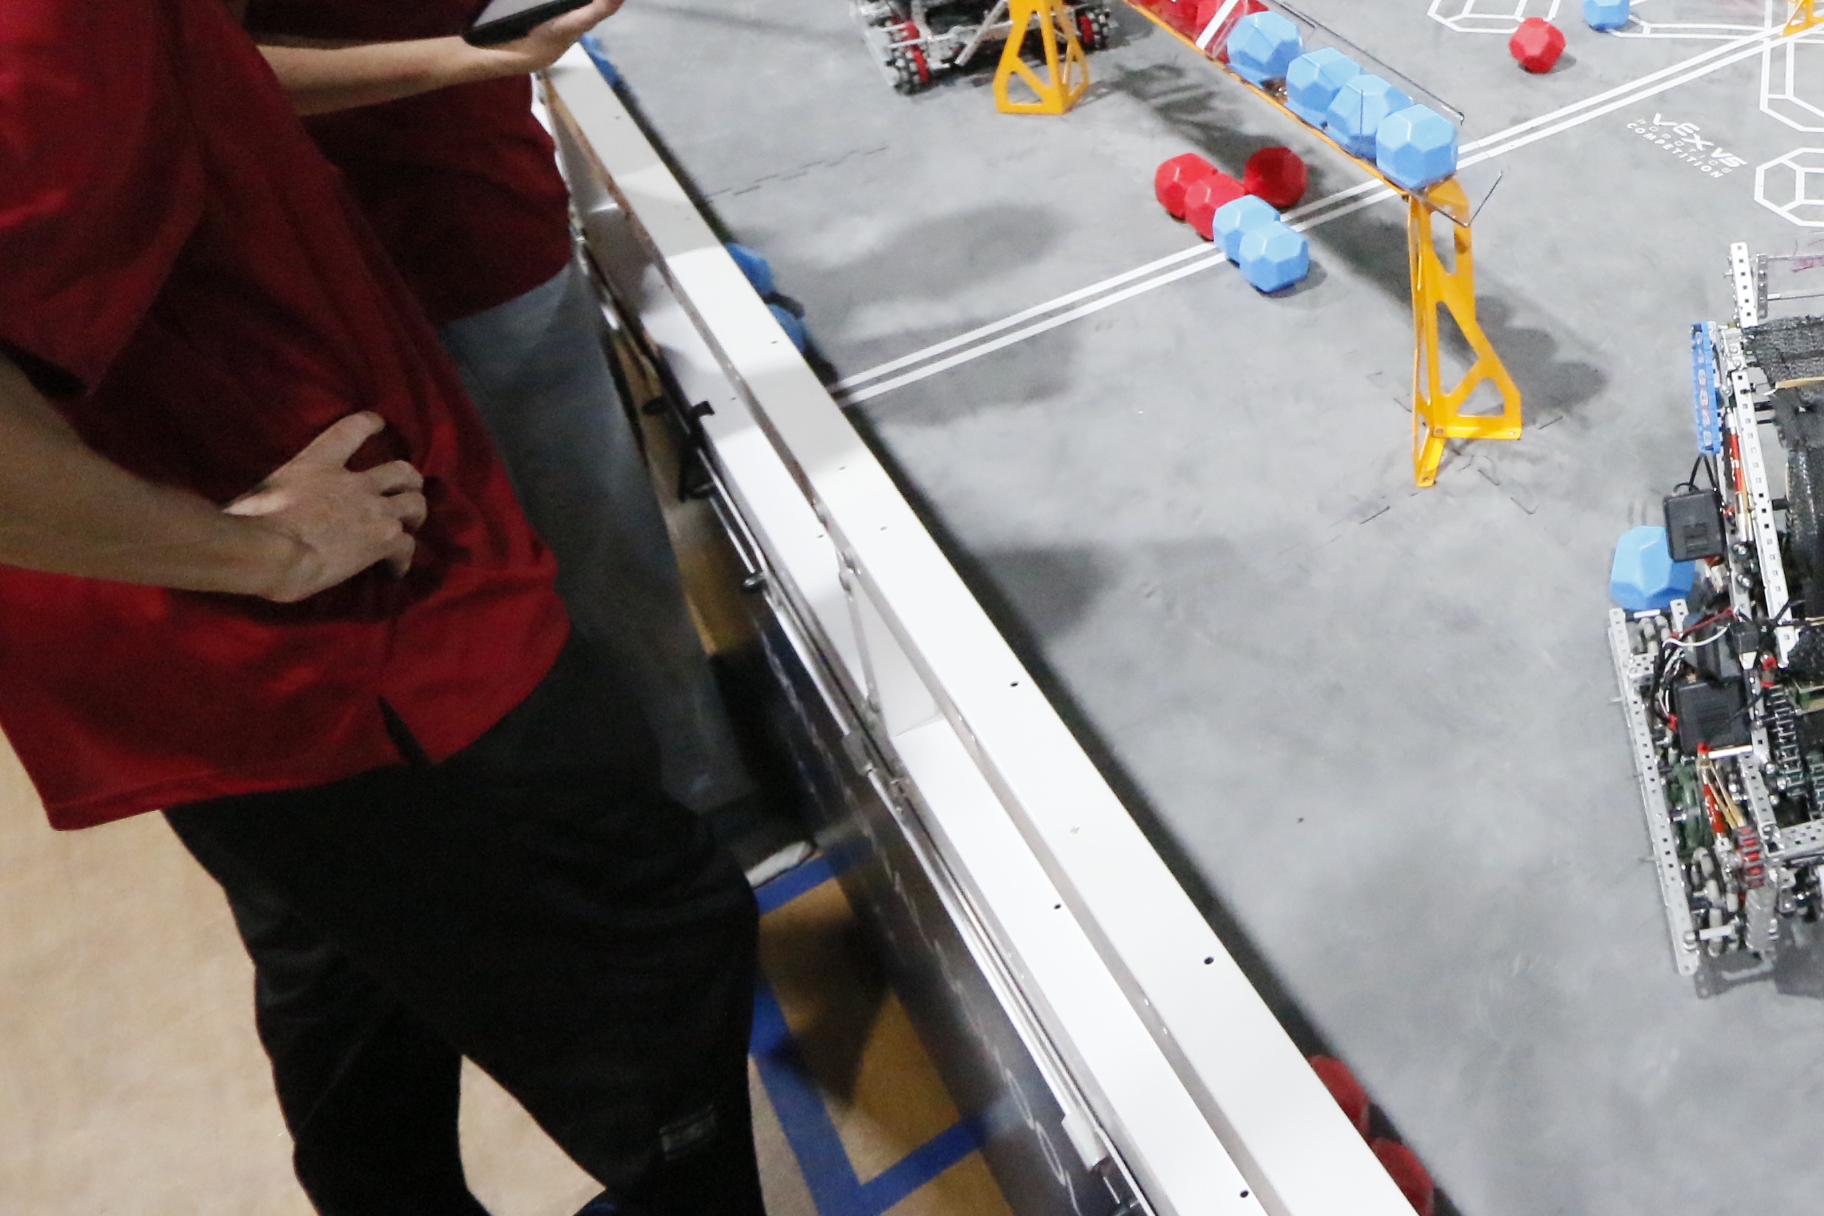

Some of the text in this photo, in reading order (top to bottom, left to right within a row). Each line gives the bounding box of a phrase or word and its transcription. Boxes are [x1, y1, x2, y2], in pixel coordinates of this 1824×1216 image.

[1626, 122, 1724, 179] COMPETITION
[1653, 112, 1749, 168] VEX V5
